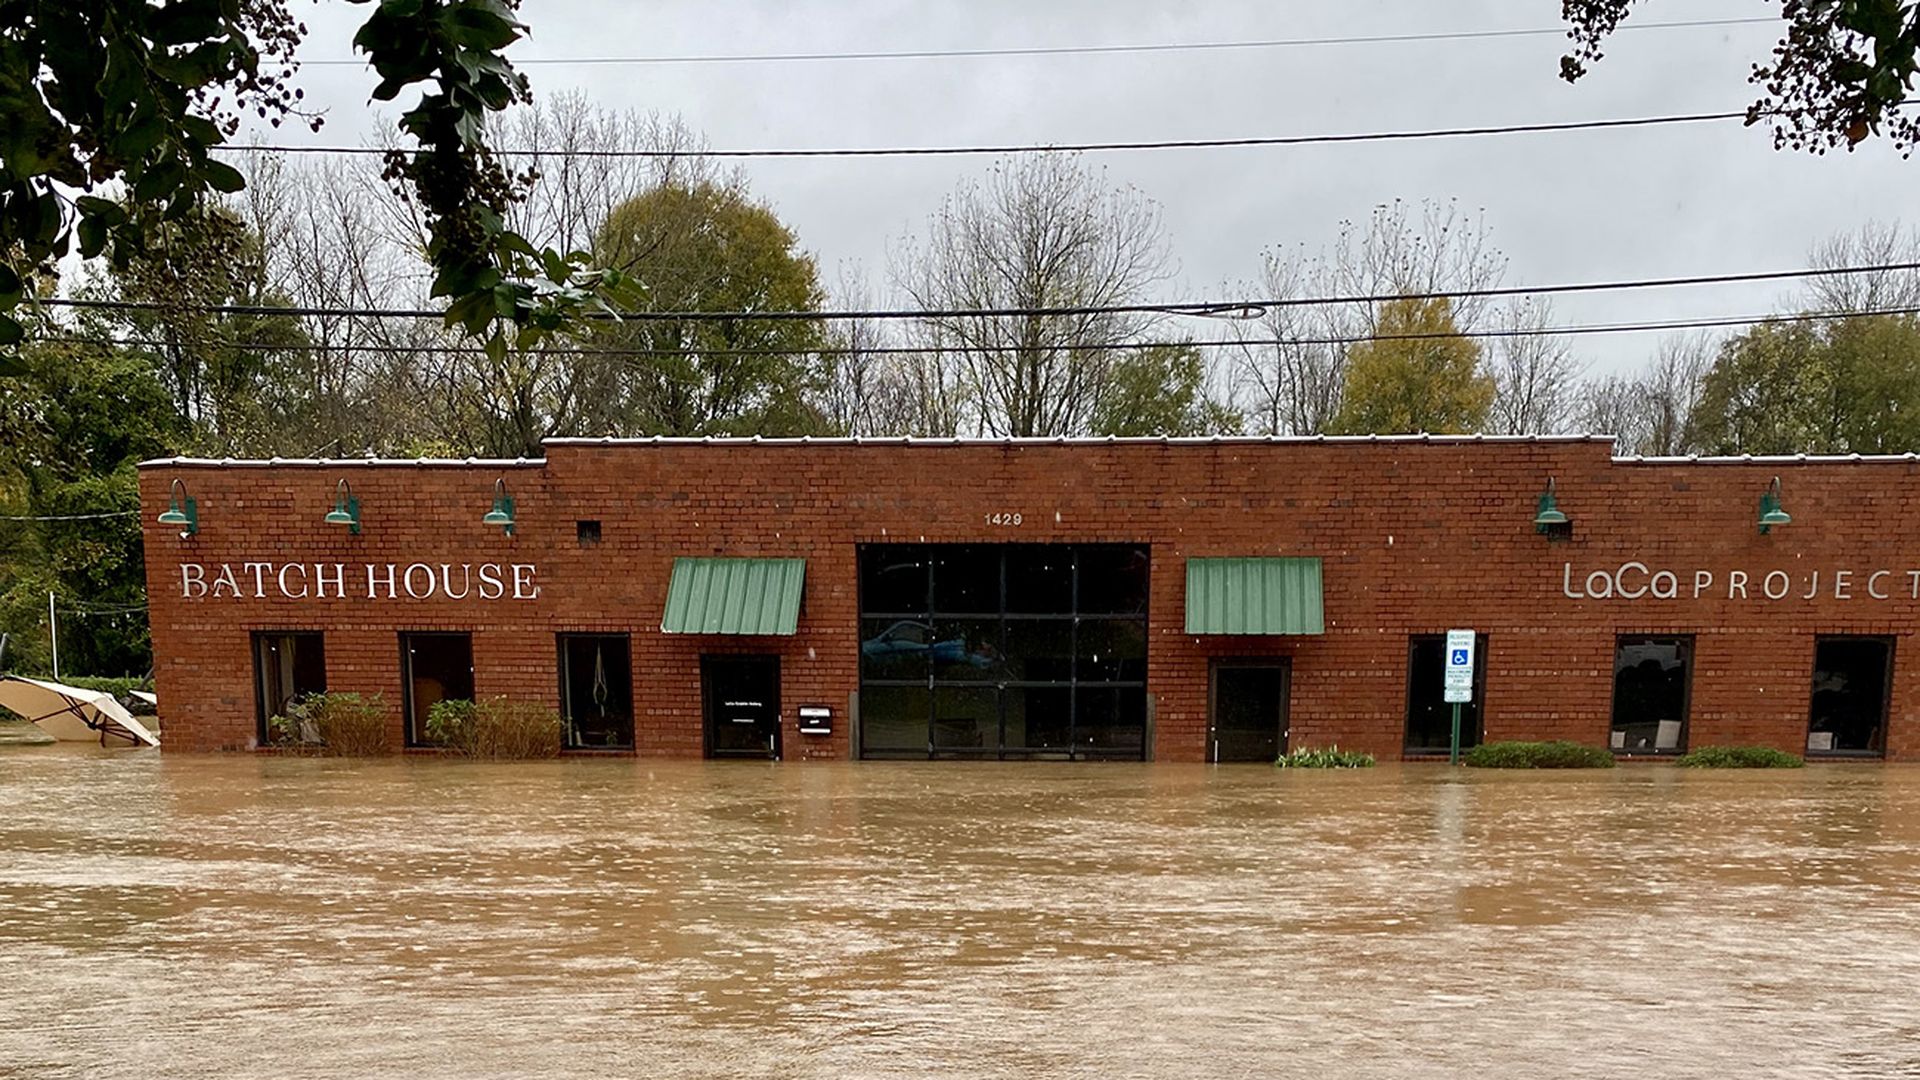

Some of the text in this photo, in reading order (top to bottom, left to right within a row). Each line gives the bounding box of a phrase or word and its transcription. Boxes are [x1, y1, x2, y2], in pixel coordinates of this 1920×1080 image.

[984, 512, 1022, 526] 1429
[180, 562, 538, 600] BATCH HOUSE
[1563, 561, 1920, 600] LaCa PROJECT
